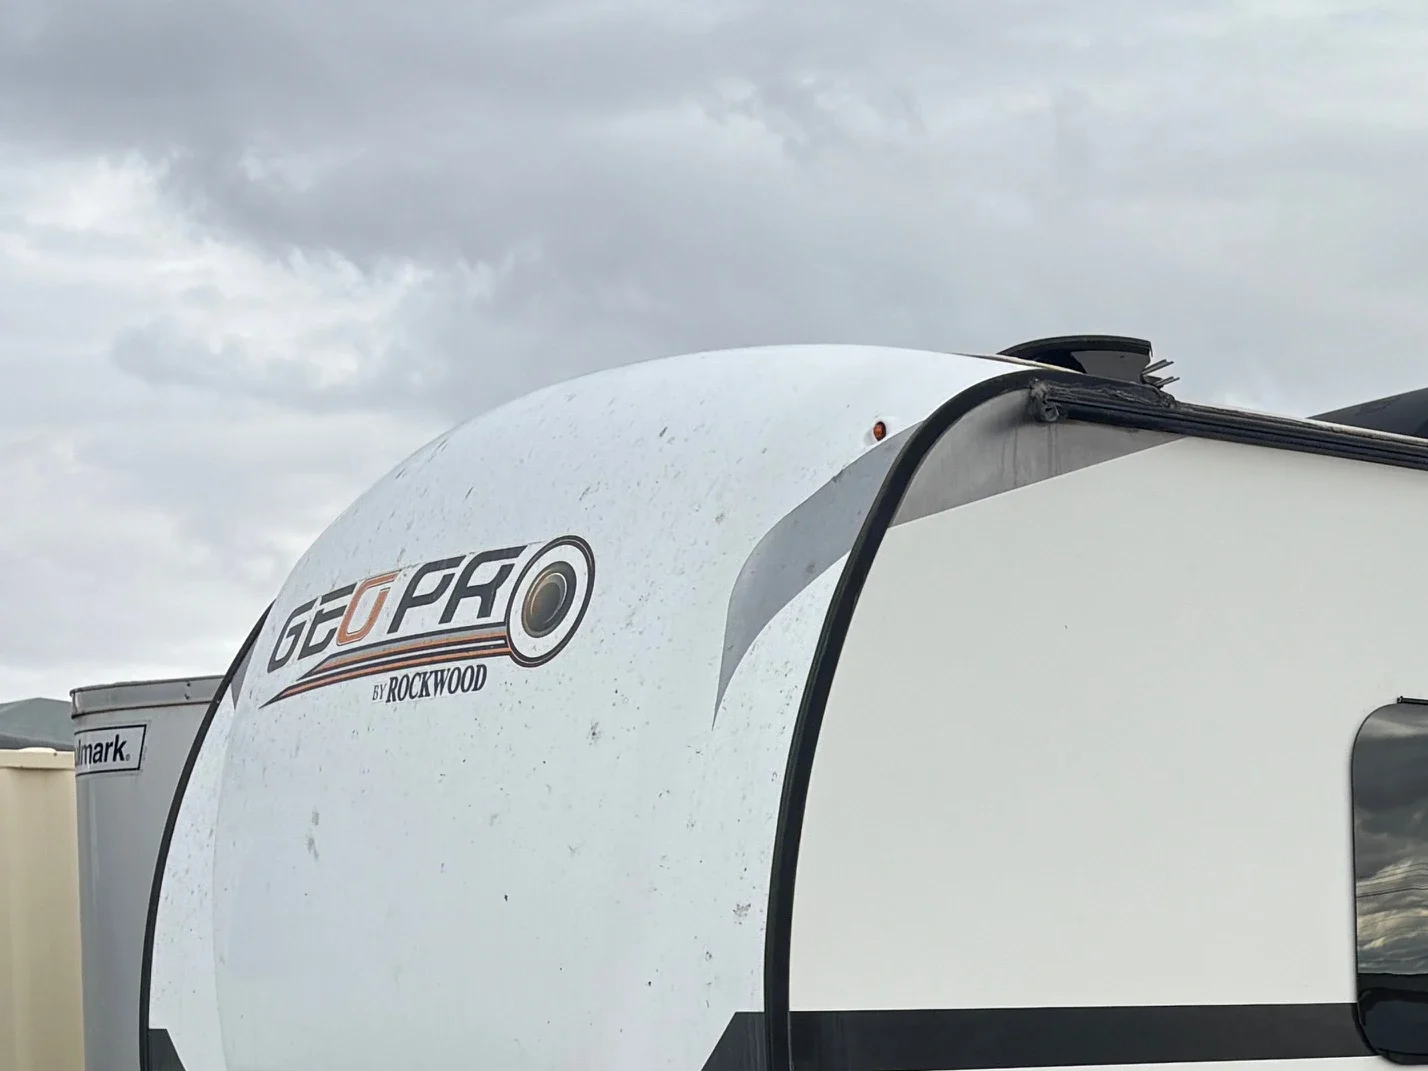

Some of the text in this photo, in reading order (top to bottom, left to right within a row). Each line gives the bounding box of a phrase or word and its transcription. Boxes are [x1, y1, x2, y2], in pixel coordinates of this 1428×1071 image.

[267, 569, 402, 674] GEO
[372, 663, 488, 704] BY ROCKWOOD
